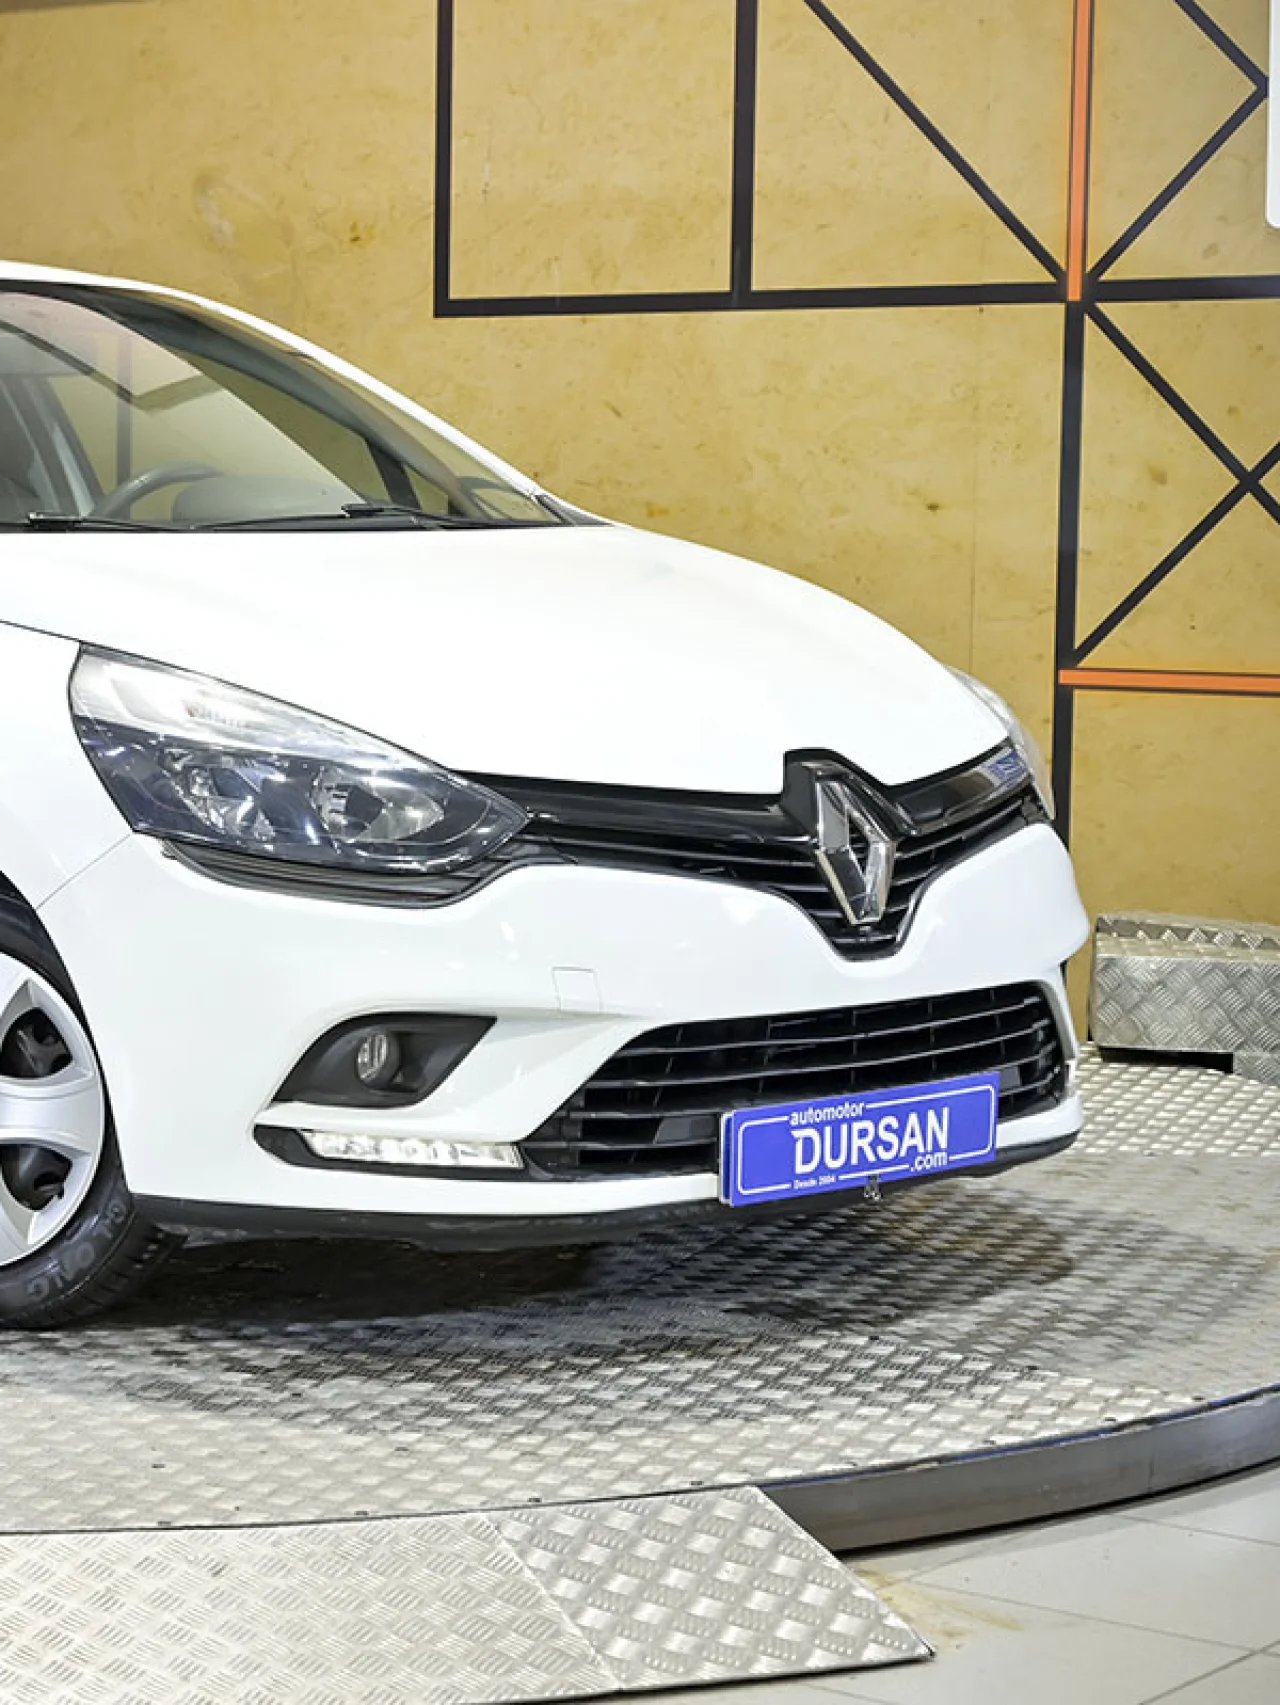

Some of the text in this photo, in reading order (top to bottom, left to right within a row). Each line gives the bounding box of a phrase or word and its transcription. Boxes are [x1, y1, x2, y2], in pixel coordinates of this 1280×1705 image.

[789, 1101, 865, 1126] automotor
[790, 1106, 950, 1175] DURSAN
[909, 1151, 948, 1173] .com
